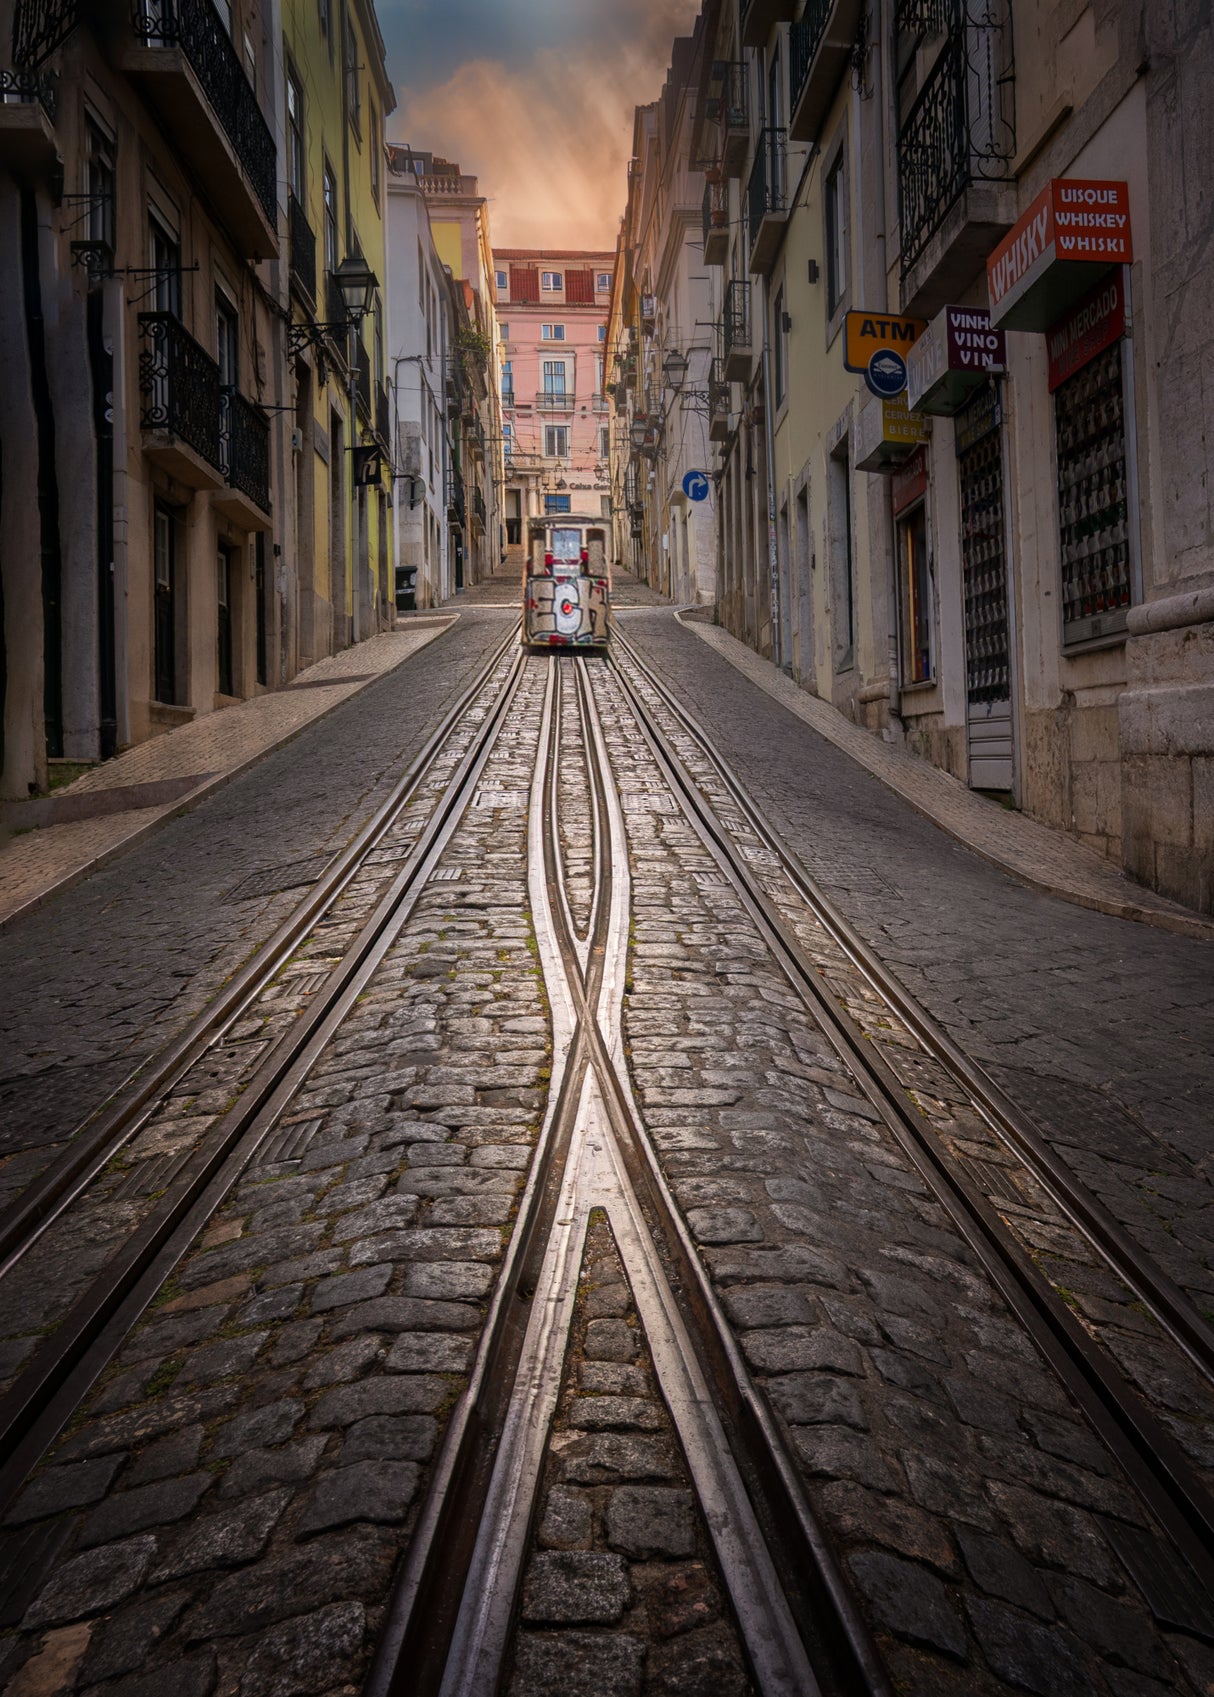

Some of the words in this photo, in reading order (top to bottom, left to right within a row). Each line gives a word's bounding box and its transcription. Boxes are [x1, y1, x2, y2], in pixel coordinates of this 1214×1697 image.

[1061, 188, 1118, 205] UISQUE
[1055, 211, 1126, 228] WHISKEY
[992, 205, 1048, 301] WHISKY
[1059, 236, 1125, 253] WHISKI
[859, 319, 916, 341] ATM
[1050, 326, 1069, 364] MINI
[1069, 284, 1118, 344] MERCADO
[954, 331, 999, 350] VINO
[960, 350, 994, 366] VIN
[884, 396, 908, 406] CERV
[884, 409, 922, 422] CERVEZ
[569, 482, 592, 490] Caixa
